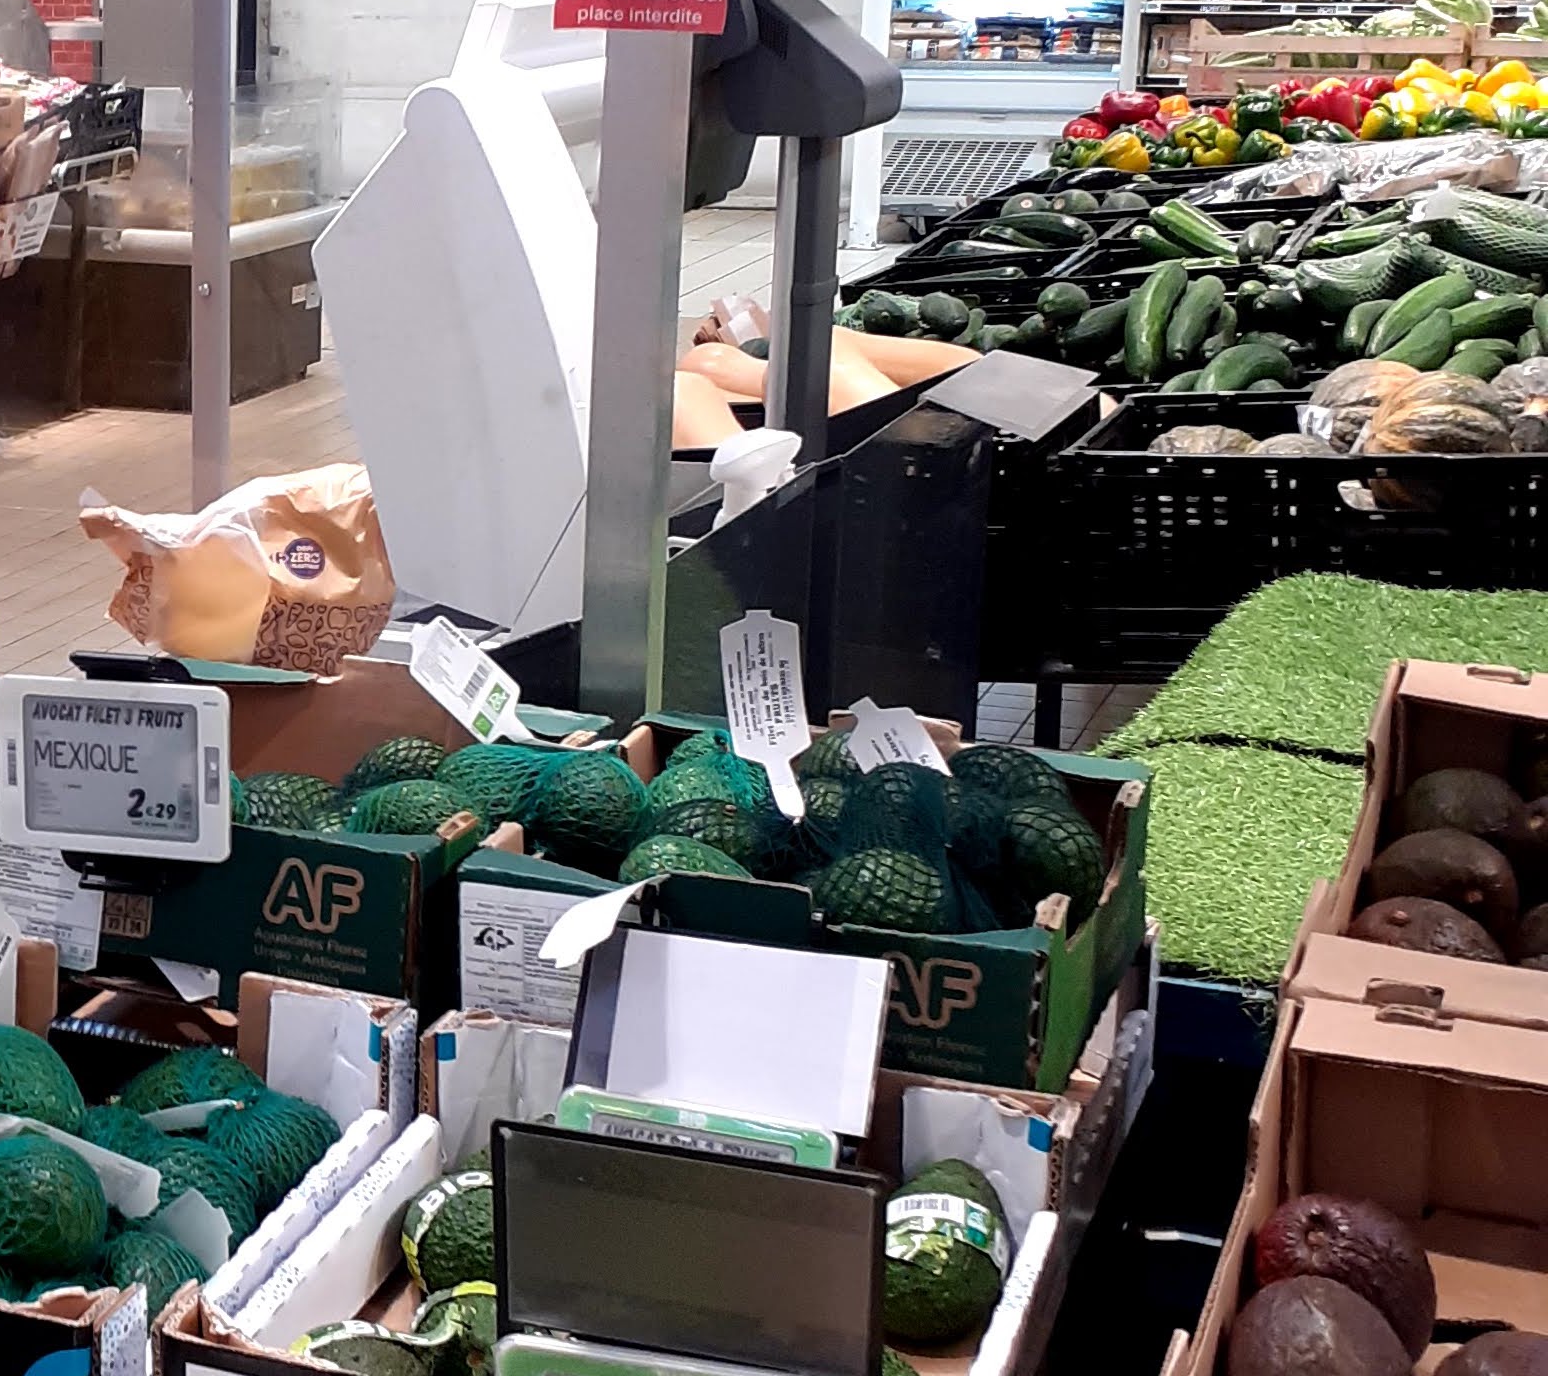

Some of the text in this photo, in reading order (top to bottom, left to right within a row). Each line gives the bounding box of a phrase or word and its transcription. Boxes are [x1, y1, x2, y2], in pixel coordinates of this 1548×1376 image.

[576, 5, 702, 26] place interdite
[33, 701, 82, 722] AVOCAT
[85, 706, 122, 725] FILET
[138, 709, 185, 729] FRUITS
[34, 739, 139, 774] MEXIQUE
[262, 857, 364, 933] AF
[418, 1171, 493, 1214] BIO
